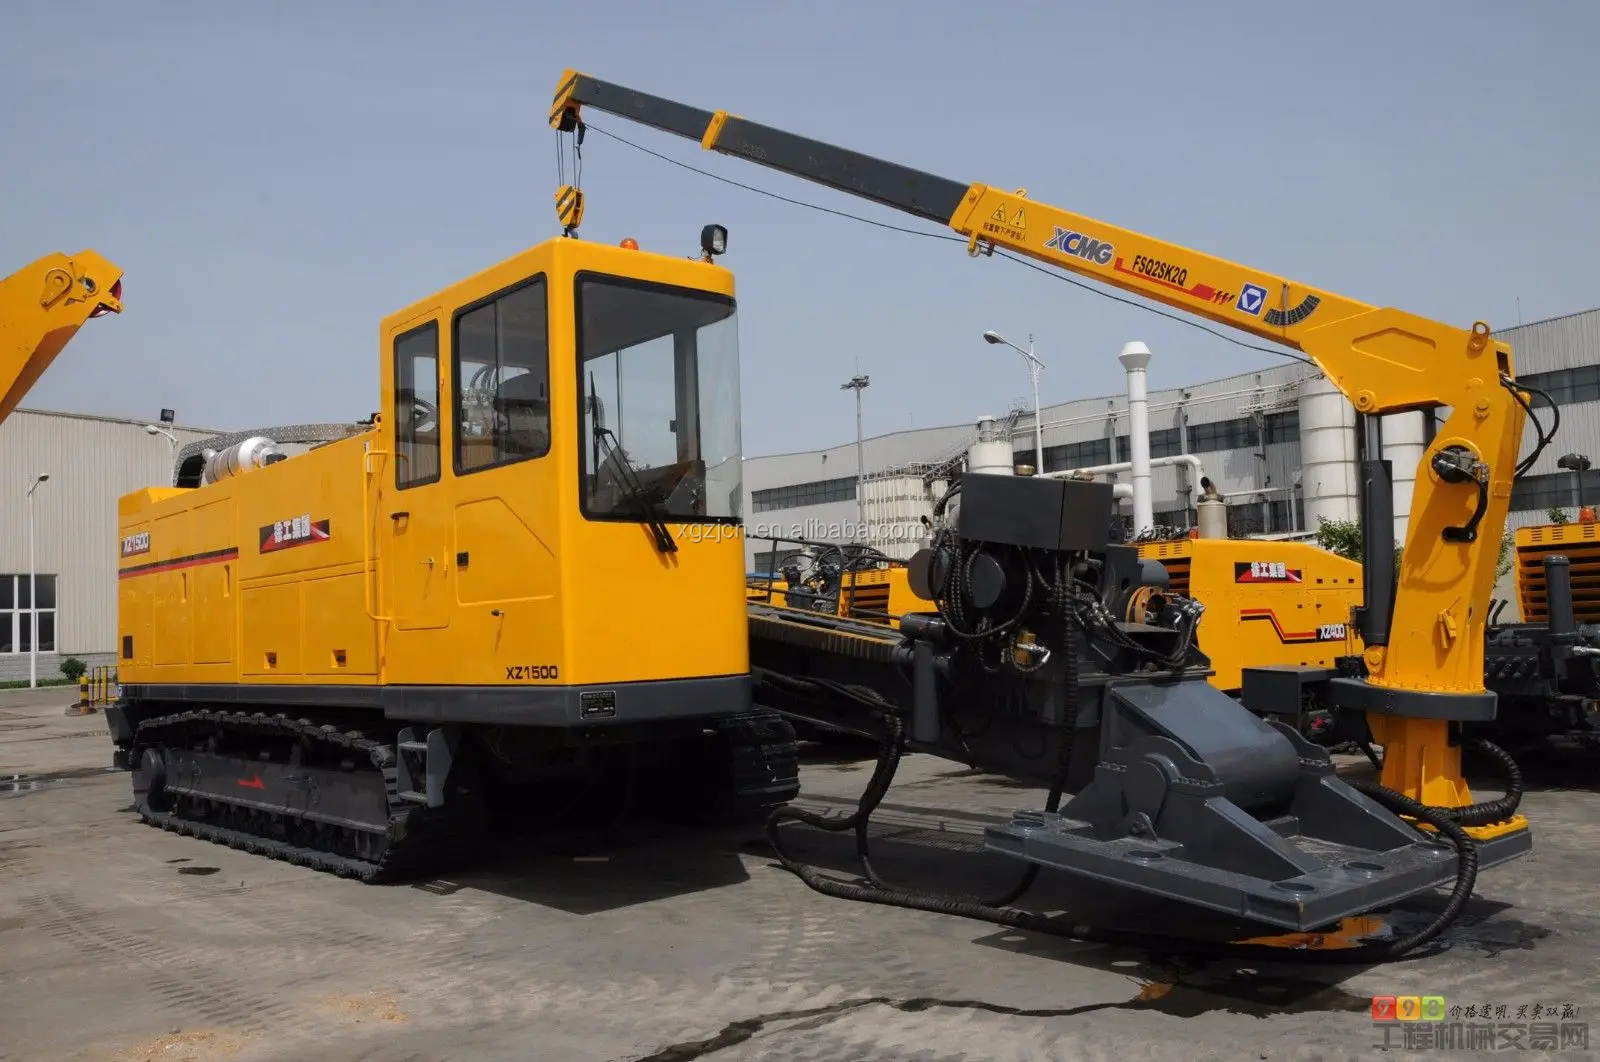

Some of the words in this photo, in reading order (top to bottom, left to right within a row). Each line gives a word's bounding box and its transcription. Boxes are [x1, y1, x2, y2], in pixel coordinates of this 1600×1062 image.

[1045, 226, 1114, 265] XCMG
[1132, 255, 1188, 287] FSQ2SK2Q
[1320, 624, 1345, 640] XZ400
[506, 666, 558, 679] XZ1500
